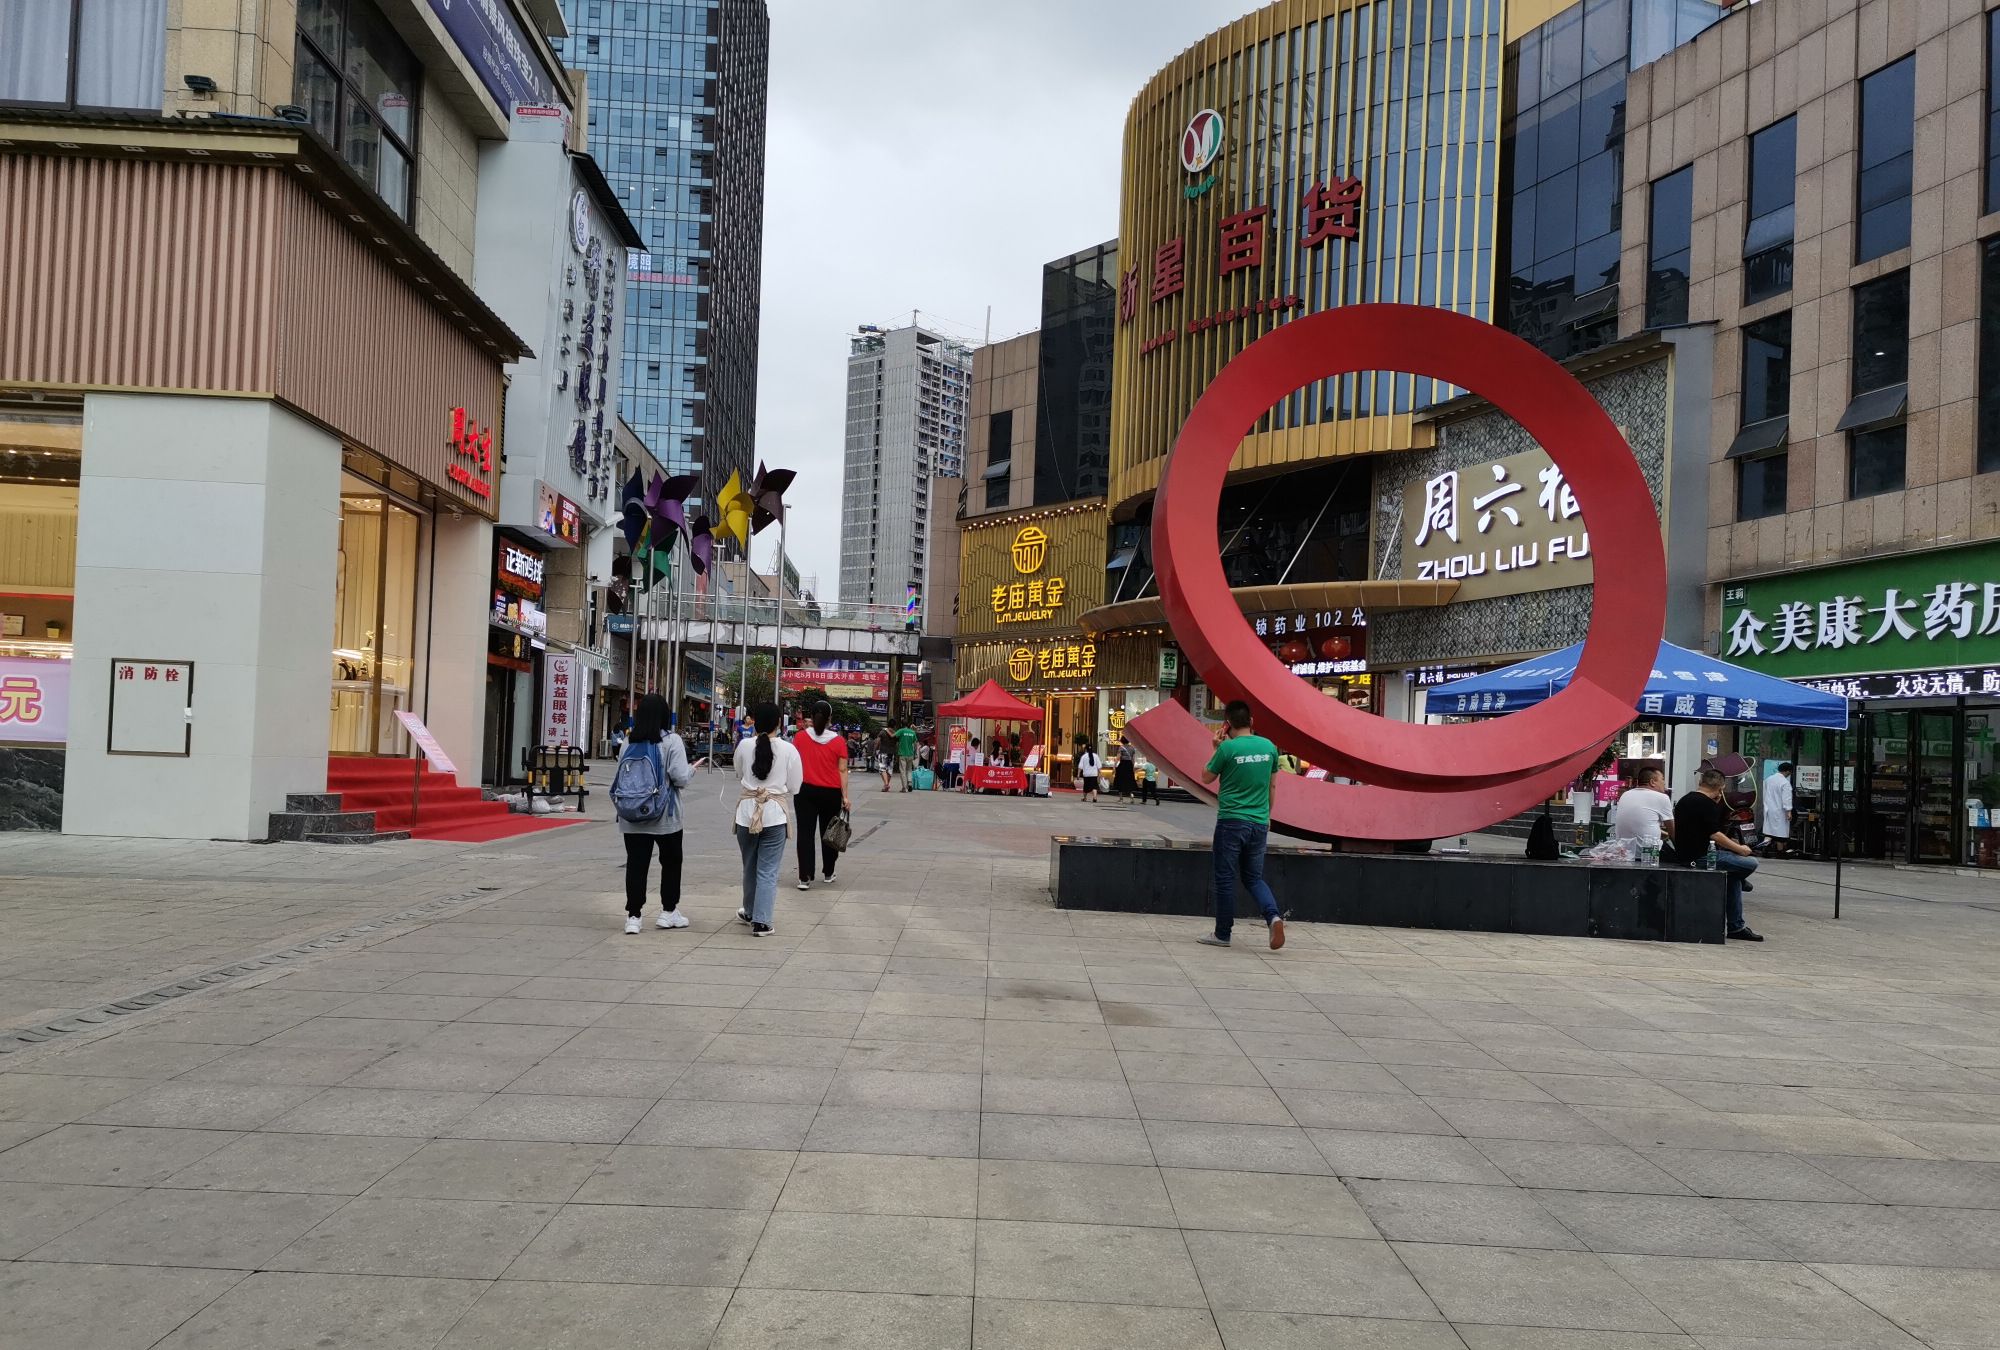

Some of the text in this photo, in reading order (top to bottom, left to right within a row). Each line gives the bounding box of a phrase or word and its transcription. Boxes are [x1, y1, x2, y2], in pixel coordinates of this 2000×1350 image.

[1121, 175, 1364, 327] 新星百货
[1417, 532, 1590, 581] ZHOU LIU FU
[990, 577, 1064, 613] 老庙黄金
[1038, 644, 1096, 670] 老庙黄金
[1163, 652, 1176, 670] 药
[119, 665, 179, 682] 消防栓
[1419, 671, 1444, 684] 周六福
[0, 679, 40, 722] 元
[552, 673, 569, 725] 精益眼镜
[1643, 693, 1758, 718] 百威雪津
